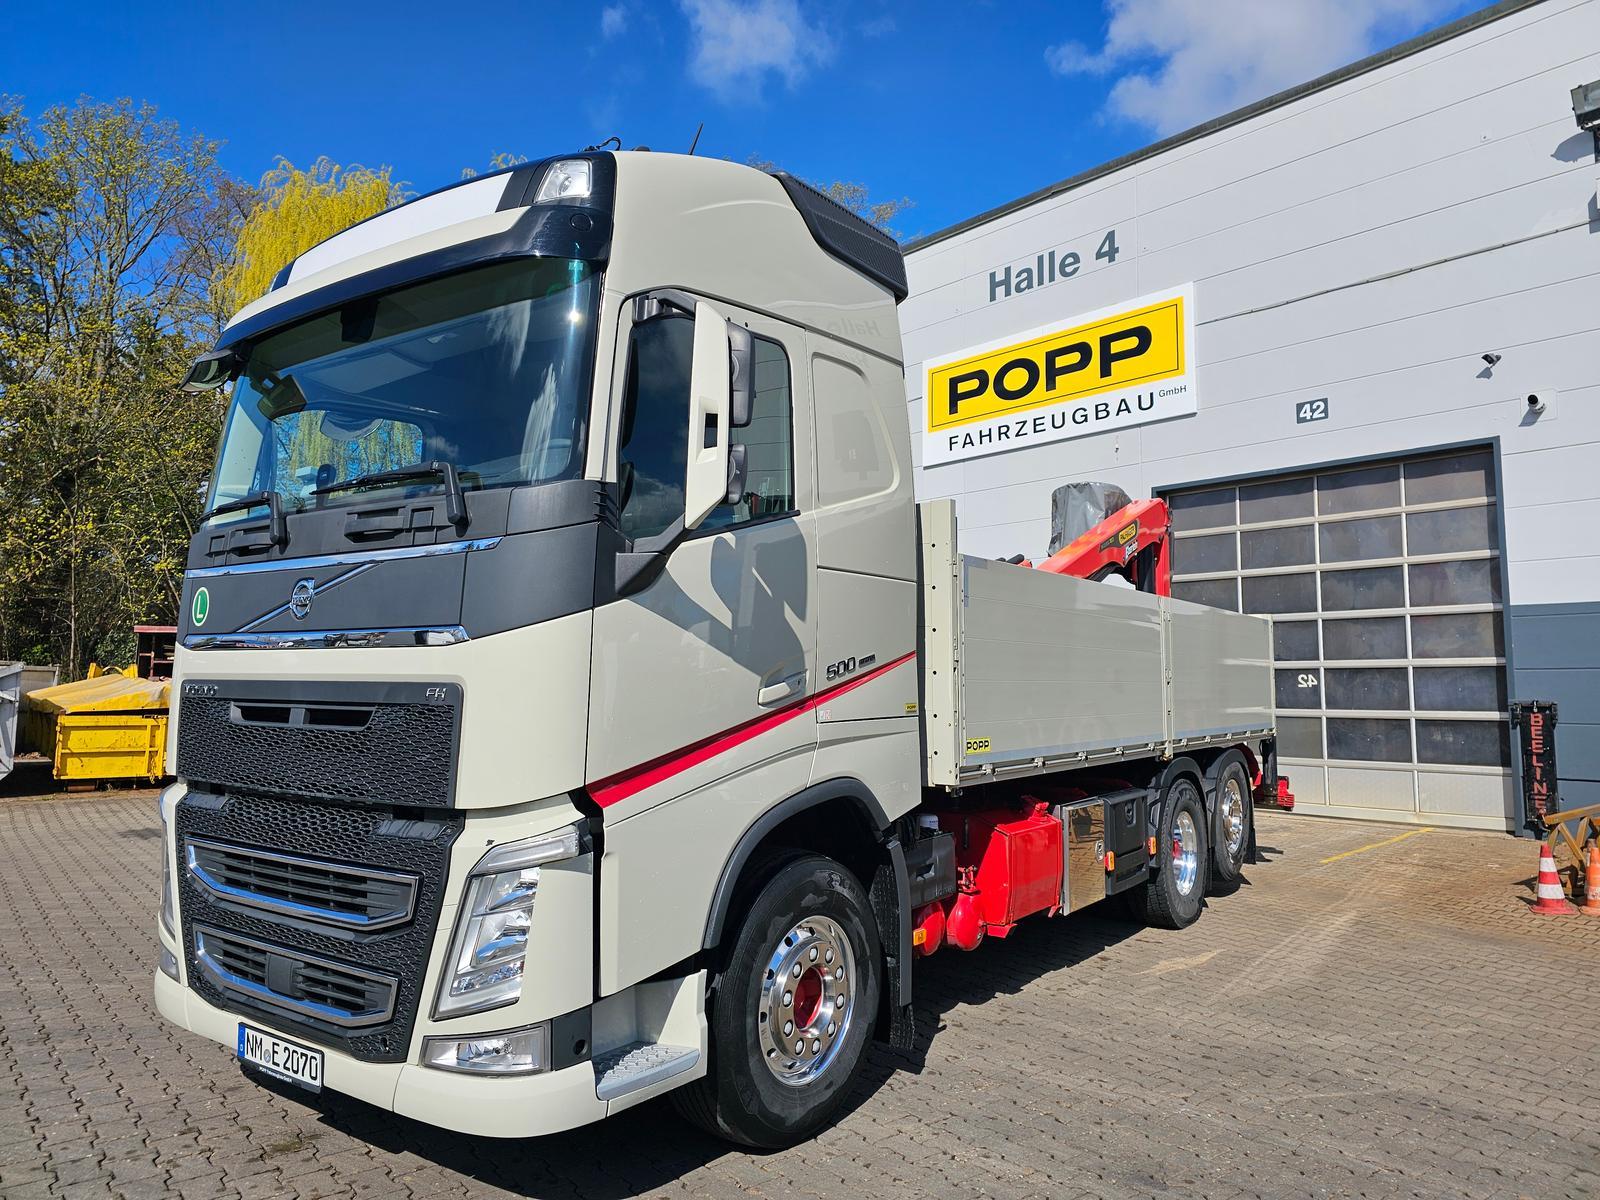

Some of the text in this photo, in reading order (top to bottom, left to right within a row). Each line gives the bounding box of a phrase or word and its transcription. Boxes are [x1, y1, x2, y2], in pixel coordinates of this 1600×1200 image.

[989, 230, 1119, 302] Halle 4
[949, 325, 1152, 415] POPP
[949, 384, 1187, 451] FAHRZEUGBAU GmbH
[1299, 400, 1326, 420] 42
[196, 594, 204, 618] L
[826, 656, 856, 681] 500
[425, 687, 447, 700] FH
[966, 739, 990, 752] POPP
[1529, 713, 1549, 813] BEELINE
[246, 1032, 262, 1060] NM
[272, 1041, 280, 1067] E
[283, 1046, 318, 1081] 2070
